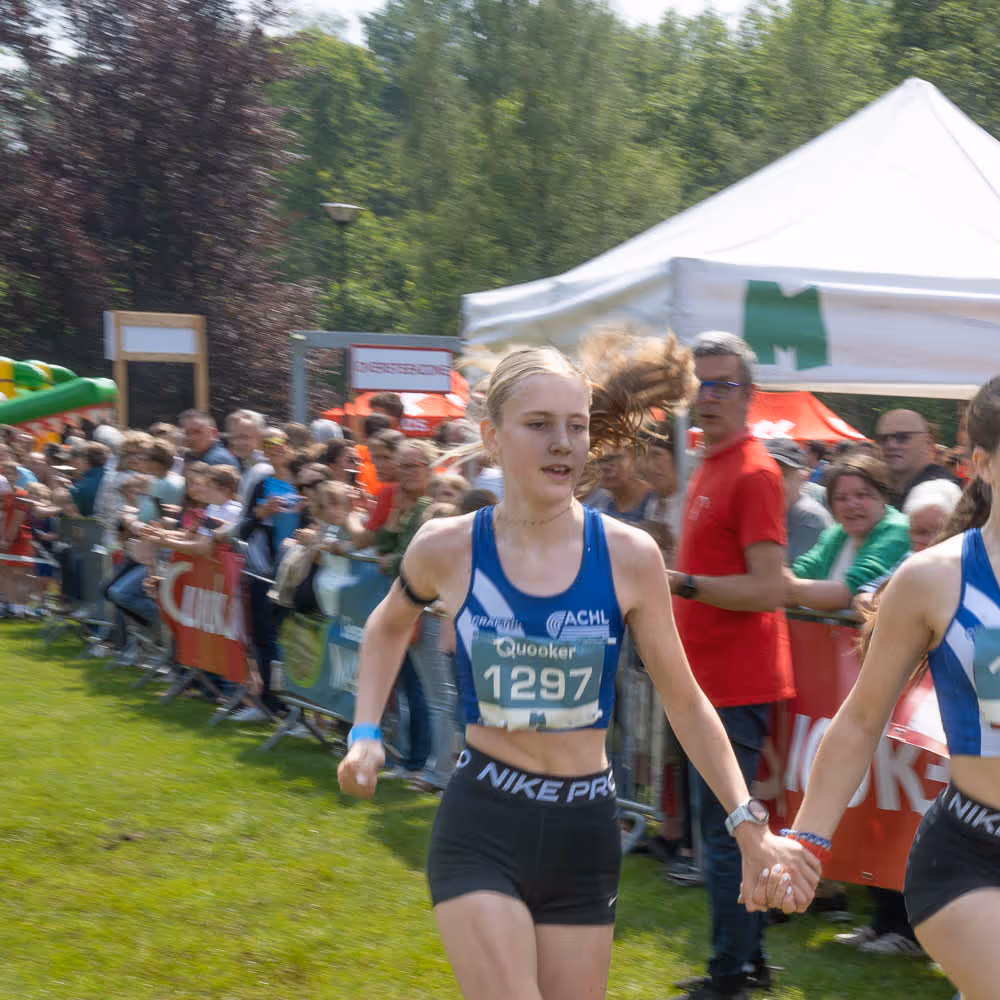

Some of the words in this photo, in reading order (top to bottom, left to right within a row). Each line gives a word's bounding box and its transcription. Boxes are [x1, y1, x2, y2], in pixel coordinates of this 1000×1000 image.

[565, 609, 610, 625] ACHL
[494, 637, 576, 660] Quooker
[483, 664, 592, 700] 1297
[476, 761, 564, 802] NIKE
